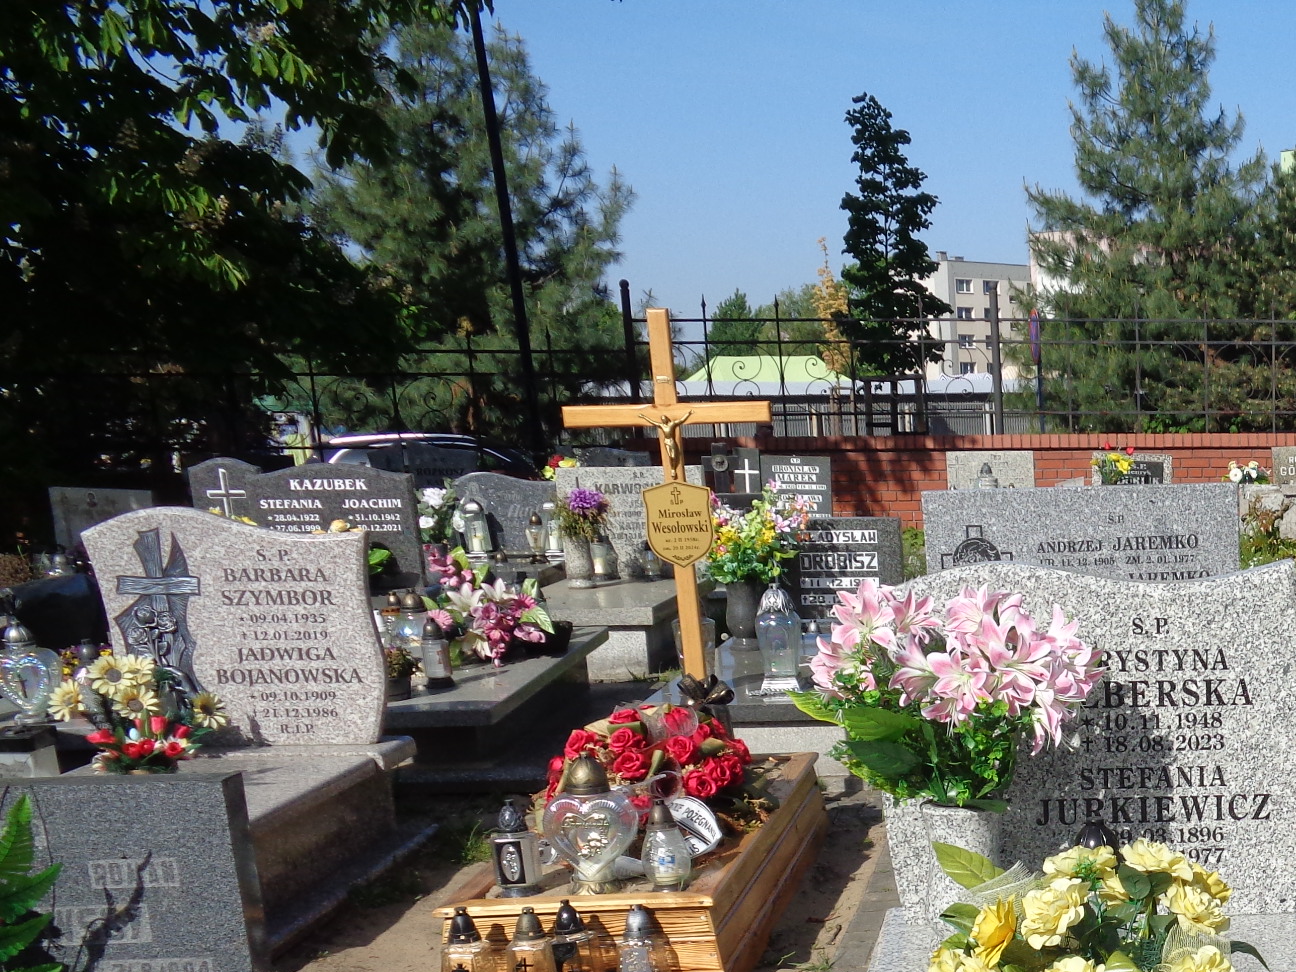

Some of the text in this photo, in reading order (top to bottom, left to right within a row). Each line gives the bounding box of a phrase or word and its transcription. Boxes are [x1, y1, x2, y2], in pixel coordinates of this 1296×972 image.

[289, 478, 367, 490] KAZUBEK
[260, 499, 322, 509] STEFANIA
[342, 498, 402, 508] JOACHIM
[658, 508, 702, 518] Mirosław
[651, 520, 709, 534] Wesołowski
[1036, 534, 1199, 554] ANDRZEJ JAREMKO
[223, 568, 329, 582] BARBARA
[221, 589, 336, 606] SZYMBOR
[251, 614, 326, 624] 09.04.1935
[1154, 618, 1170, 635] P.
[254, 631, 328, 641] 12.01.2019
[236, 647, 336, 664] JADWIGA
[1097, 648, 1228, 672] RYSTYNA
[216, 668, 364, 686] BOJANOWSKA
[261, 691, 337, 701] 09.10.1909
[263, 708, 338, 718] 21.12.1986
[1104, 712, 1222, 731] 10.11.1948
[1105, 734, 1225, 753] 18.08.2023
[1080, 765, 1227, 790] STEFANIA
[1036, 794, 1273, 826] JURKIEWICZ
